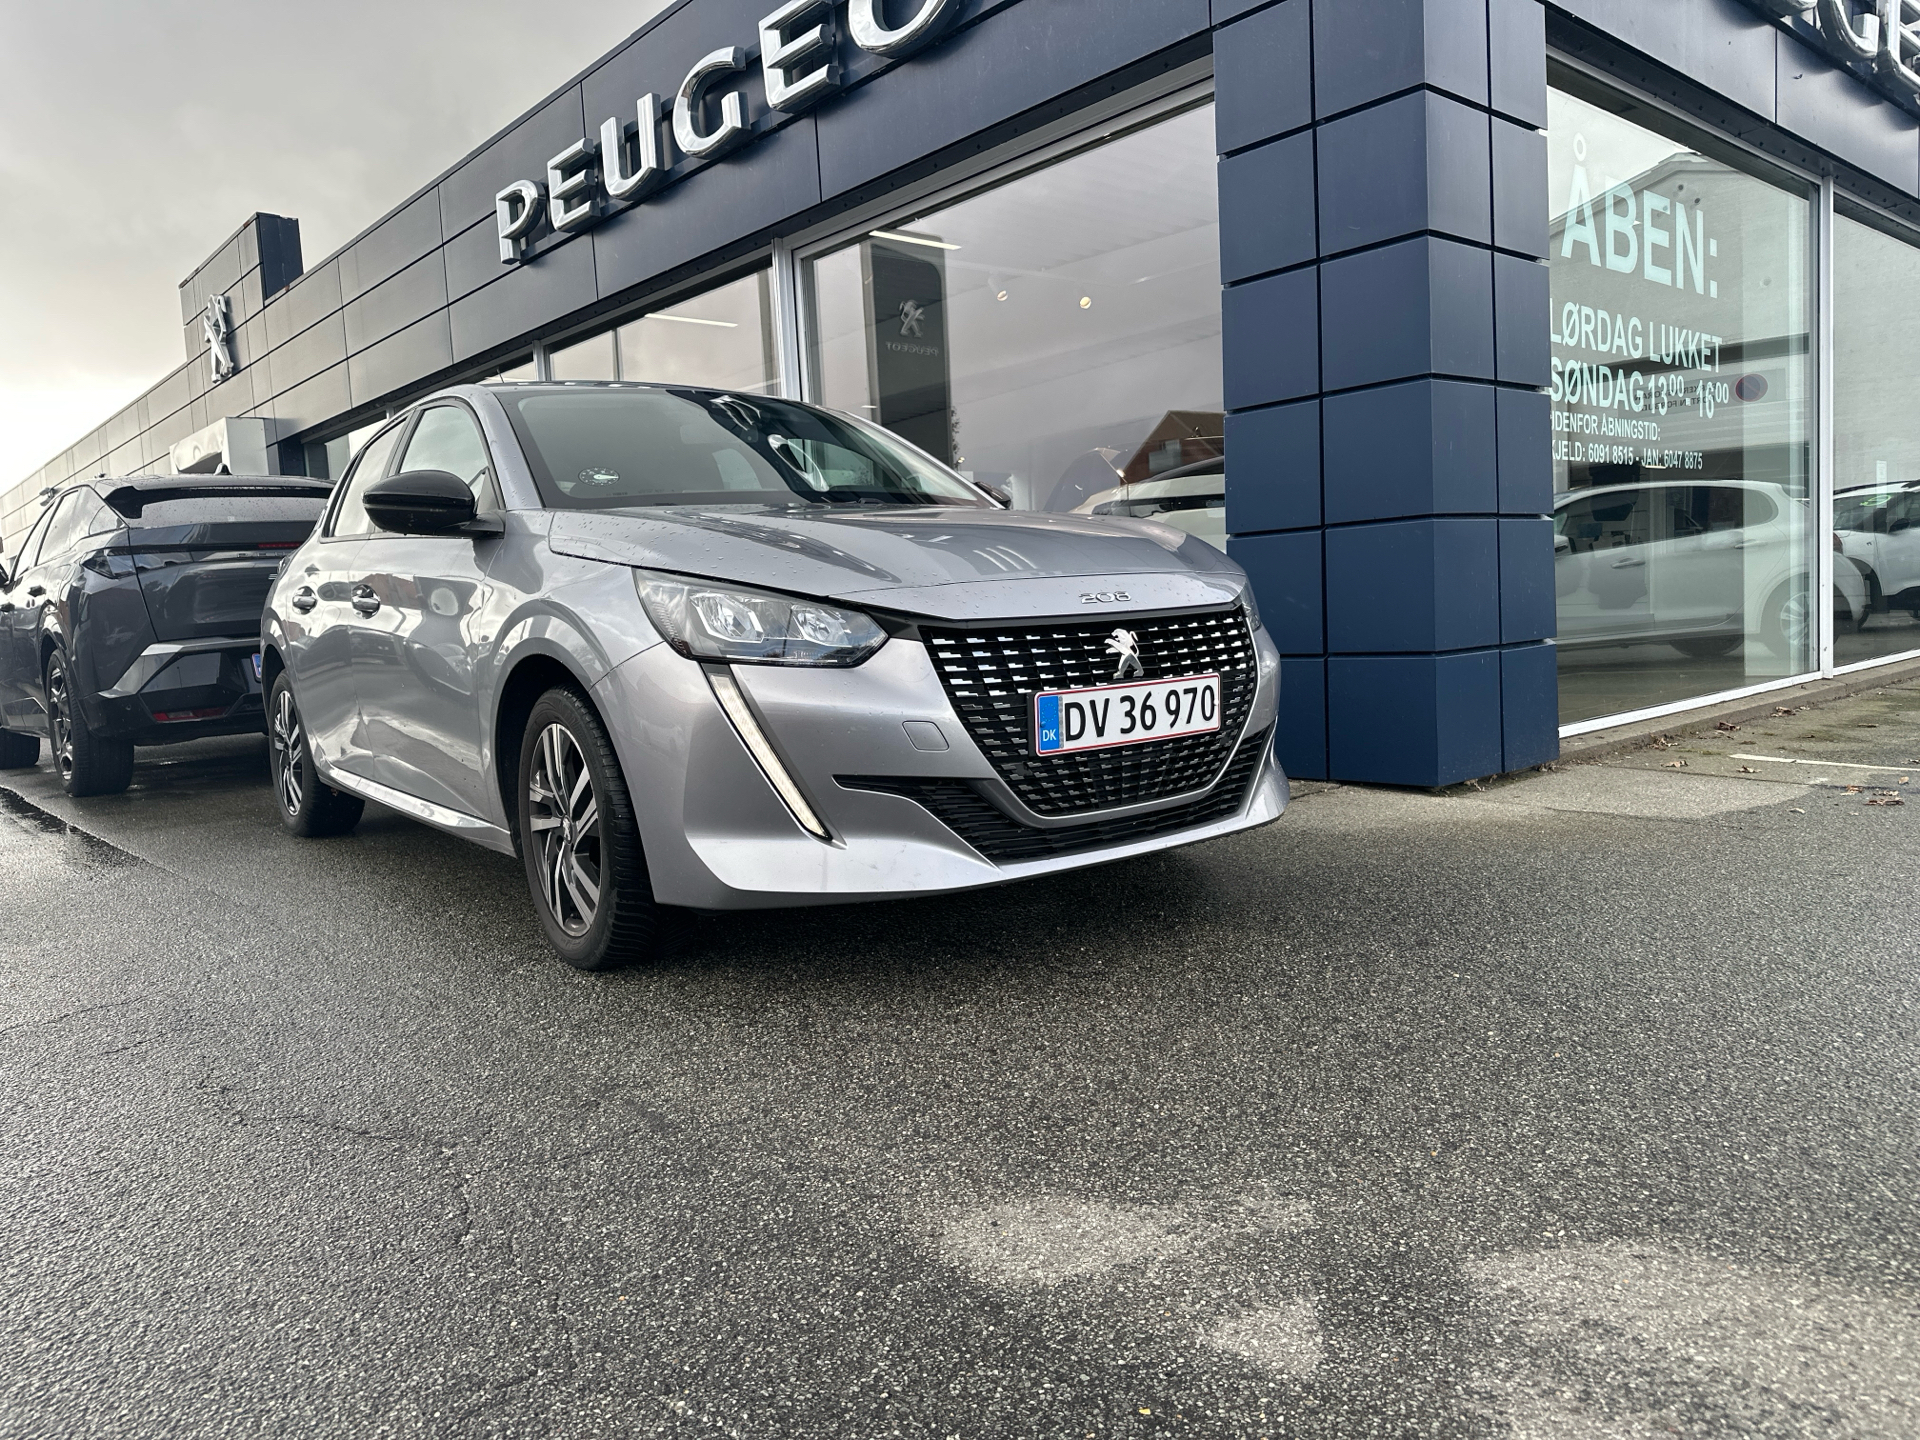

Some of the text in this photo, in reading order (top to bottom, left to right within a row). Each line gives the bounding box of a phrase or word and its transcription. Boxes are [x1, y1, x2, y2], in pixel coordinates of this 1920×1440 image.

[1561, 132, 1718, 299] ÅBEN:
[1550, 298, 1723, 373] LØRDAG LUKKET
[1551, 356, 1644, 413] SØNDAG
[1601, 413, 1661, 441] ÅBNINGSTID:
[1588, 443, 1610, 464] 6091
[1612, 445, 1634, 466] 8515
[1641, 447, 1662, 467] JAN:
[1664, 449, 1683, 468] 6047
[1684, 450, 1703, 470] 8875
[1078, 590, 1132, 604] 208
[1042, 728, 1057, 741] DK
[1064, 685, 1216, 742] DV 36 970
